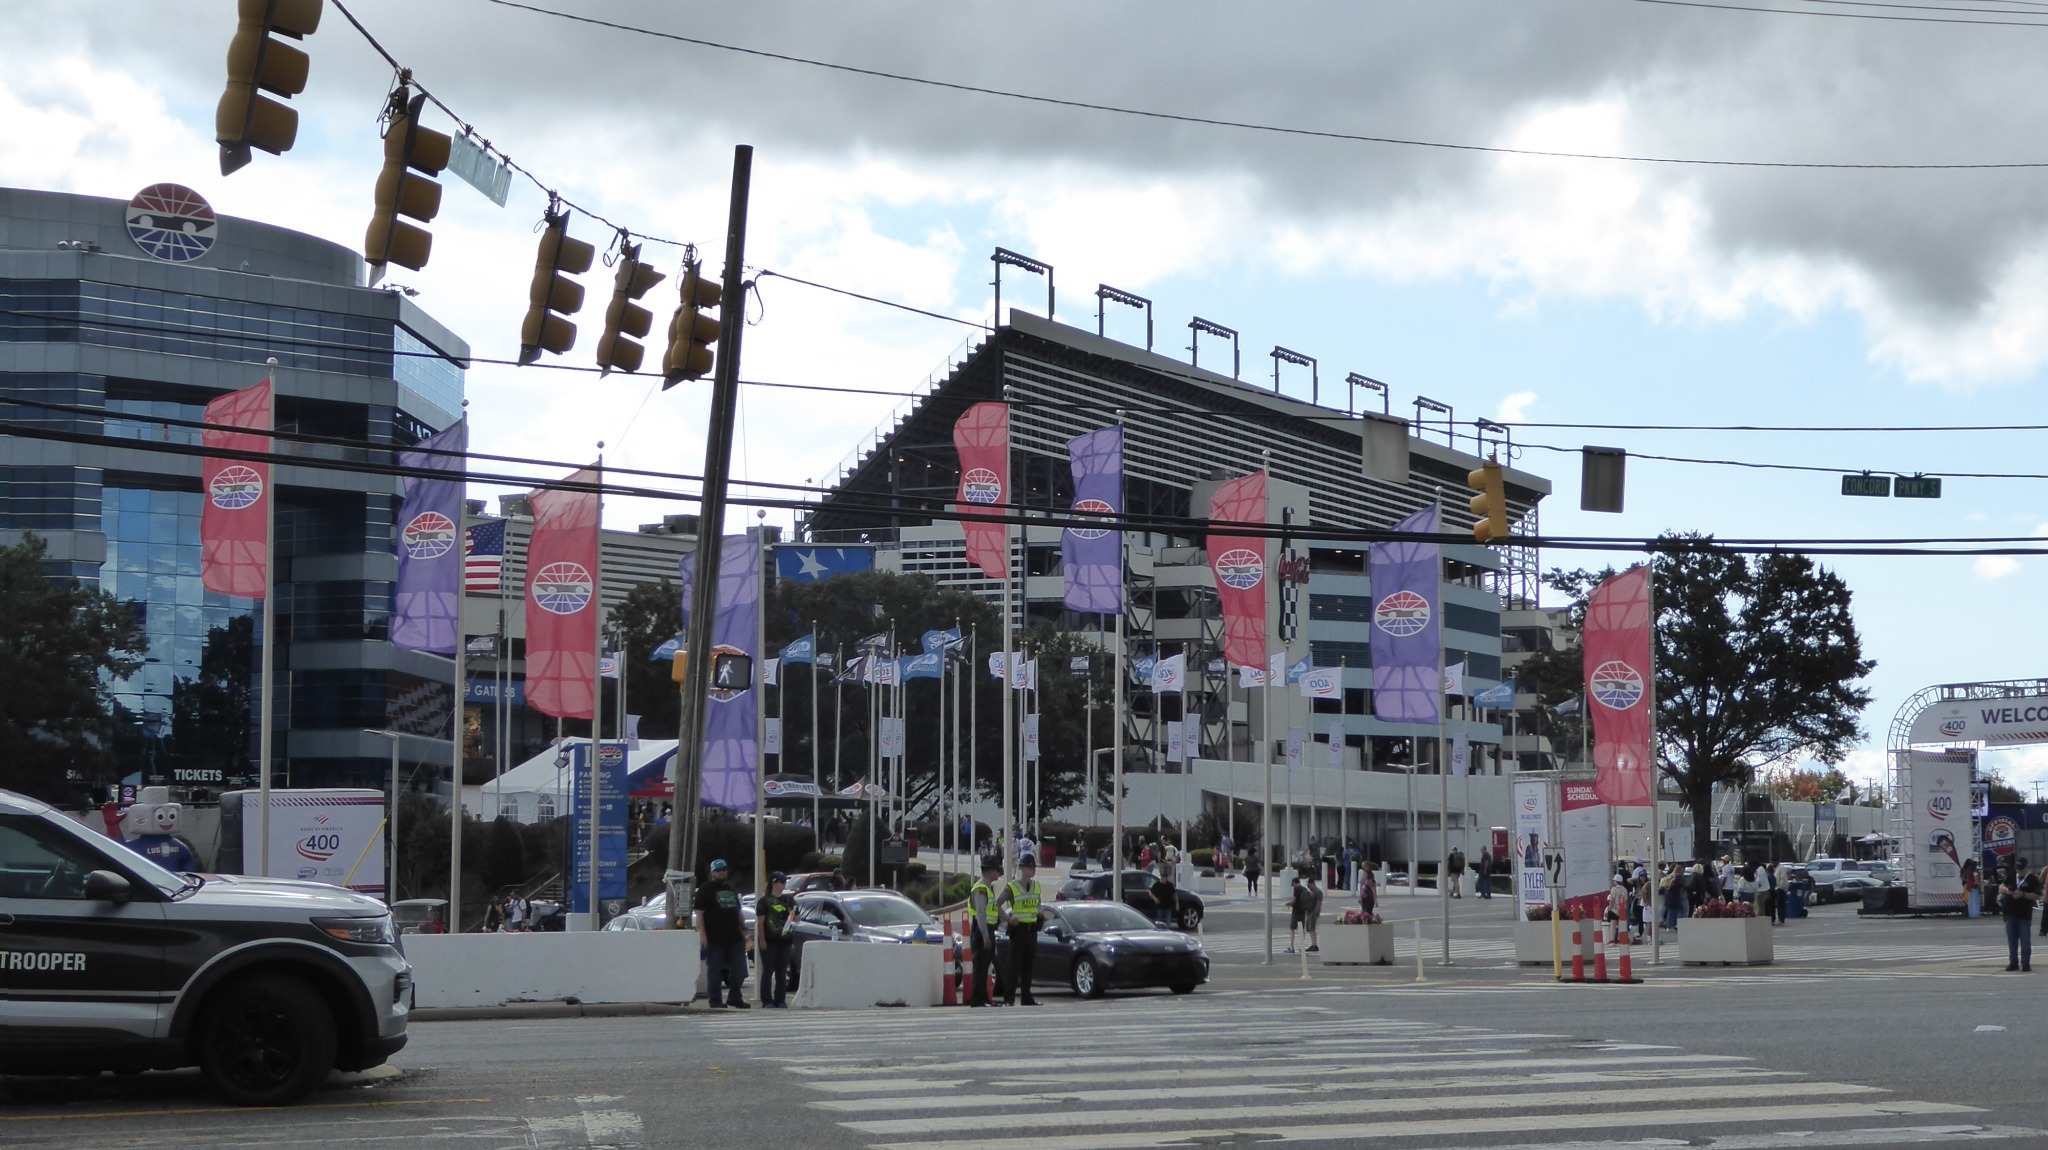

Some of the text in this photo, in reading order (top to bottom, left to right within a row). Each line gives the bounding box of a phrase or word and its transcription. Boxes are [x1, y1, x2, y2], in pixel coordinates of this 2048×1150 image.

[1845, 478, 1937, 495] CONCORD PKWY S
[1945, 720, 1966, 730] 400
[174, 769, 223, 781] TICKETS
[578, 771, 611, 779] PARNG
[1932, 796, 1952, 811] 400
[306, 834, 340, 850] 400
[1983, 839, 2016, 848] SOUVENI
[1523, 873, 1545, 889] TYLER
[0, 952, 87, 971] TROOPER
